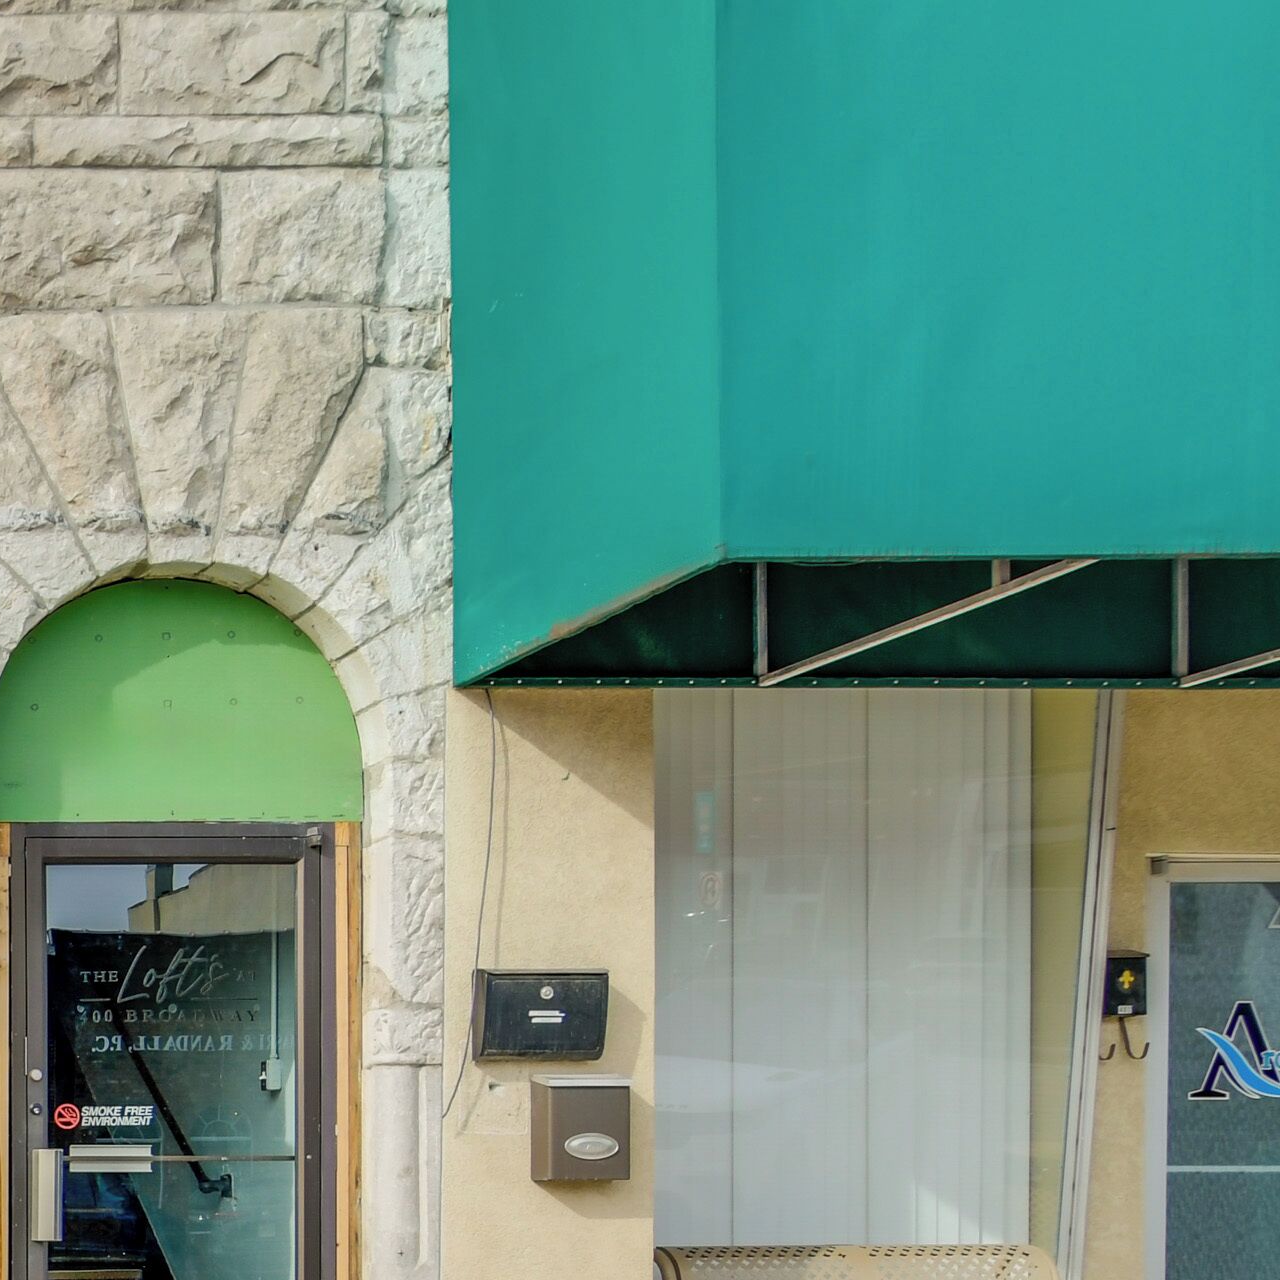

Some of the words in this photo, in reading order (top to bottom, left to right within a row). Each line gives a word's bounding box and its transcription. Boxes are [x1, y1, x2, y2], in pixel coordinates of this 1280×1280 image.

[80, 971, 119, 983] THE
[124, 1008, 259, 1023] BROADWAY
[81, 1105, 122, 1116] SMOKE
[124, 1105, 154, 1116] FREE
[81, 1116, 153, 1127] ENVIRONMENT
